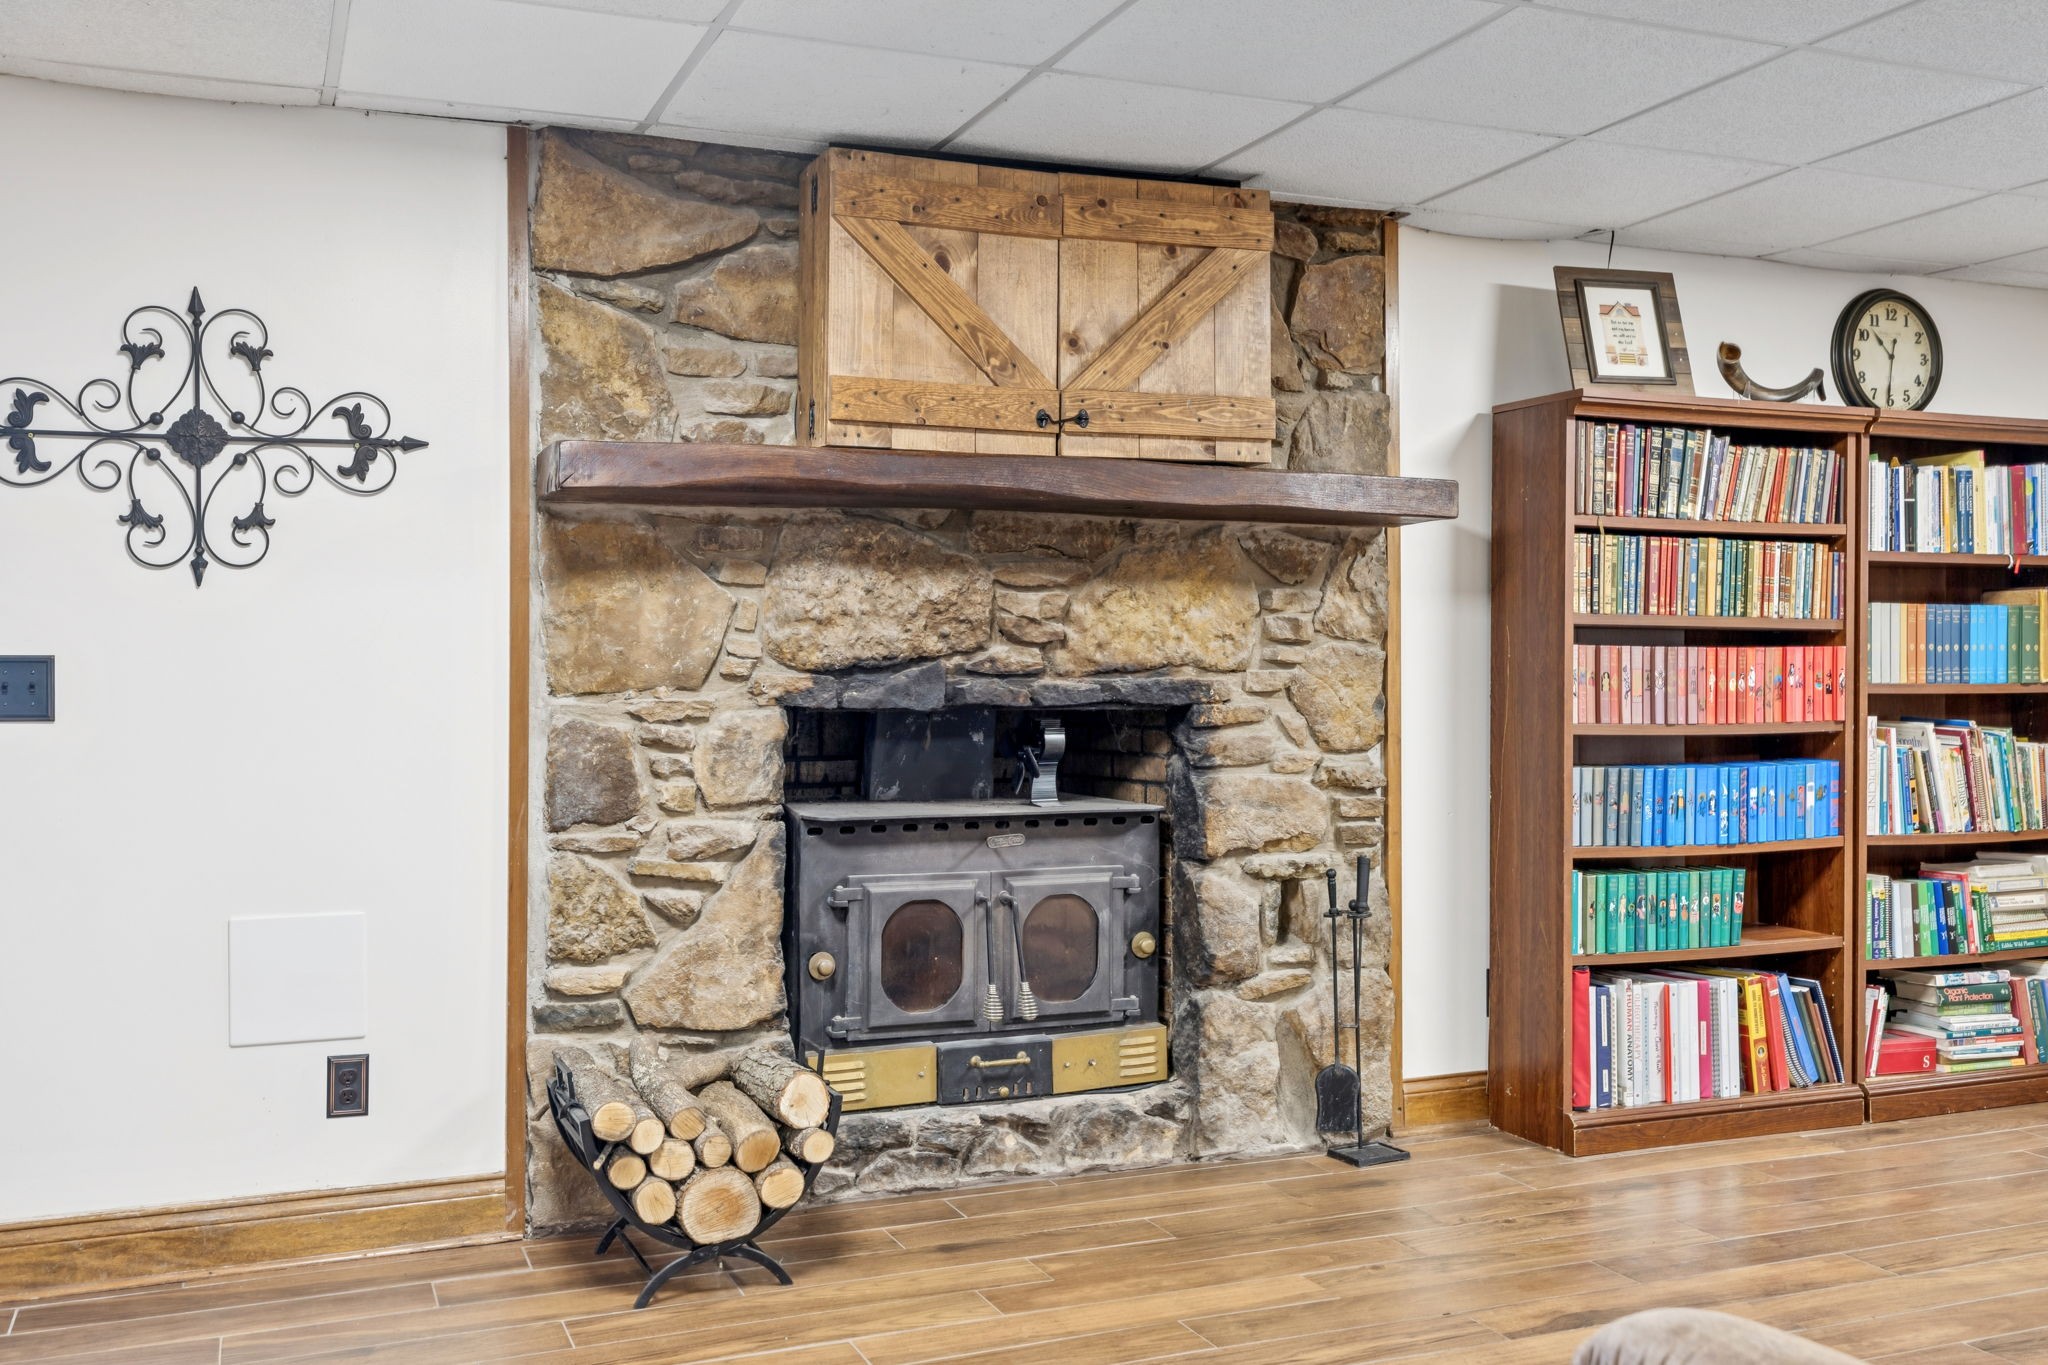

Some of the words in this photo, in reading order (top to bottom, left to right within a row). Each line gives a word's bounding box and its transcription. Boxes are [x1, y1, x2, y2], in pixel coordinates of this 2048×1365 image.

[1870, 314, 1880, 327] 11
[1885, 308, 1897, 321] 12
[1904, 315, 1908, 328] 1
[1858, 328, 1869, 341] 10
[1914, 332, 1922, 344] 2
[1853, 349, 1860, 360] 9
[1920, 354, 1927, 366] 3
[1858, 371, 1866, 383] 8
[1914, 374, 1922, 387] 4
[1870, 388, 1877, 400] 7
[1903, 390, 1910, 402] 5
[1887, 394, 1894, 407] 6
[1868, 750, 1876, 810] MEDICINE
[1957, 779, 1966, 806] HERBS
[1944, 987, 1968, 996] Organic
[1923, 1056, 1930, 1068] S
